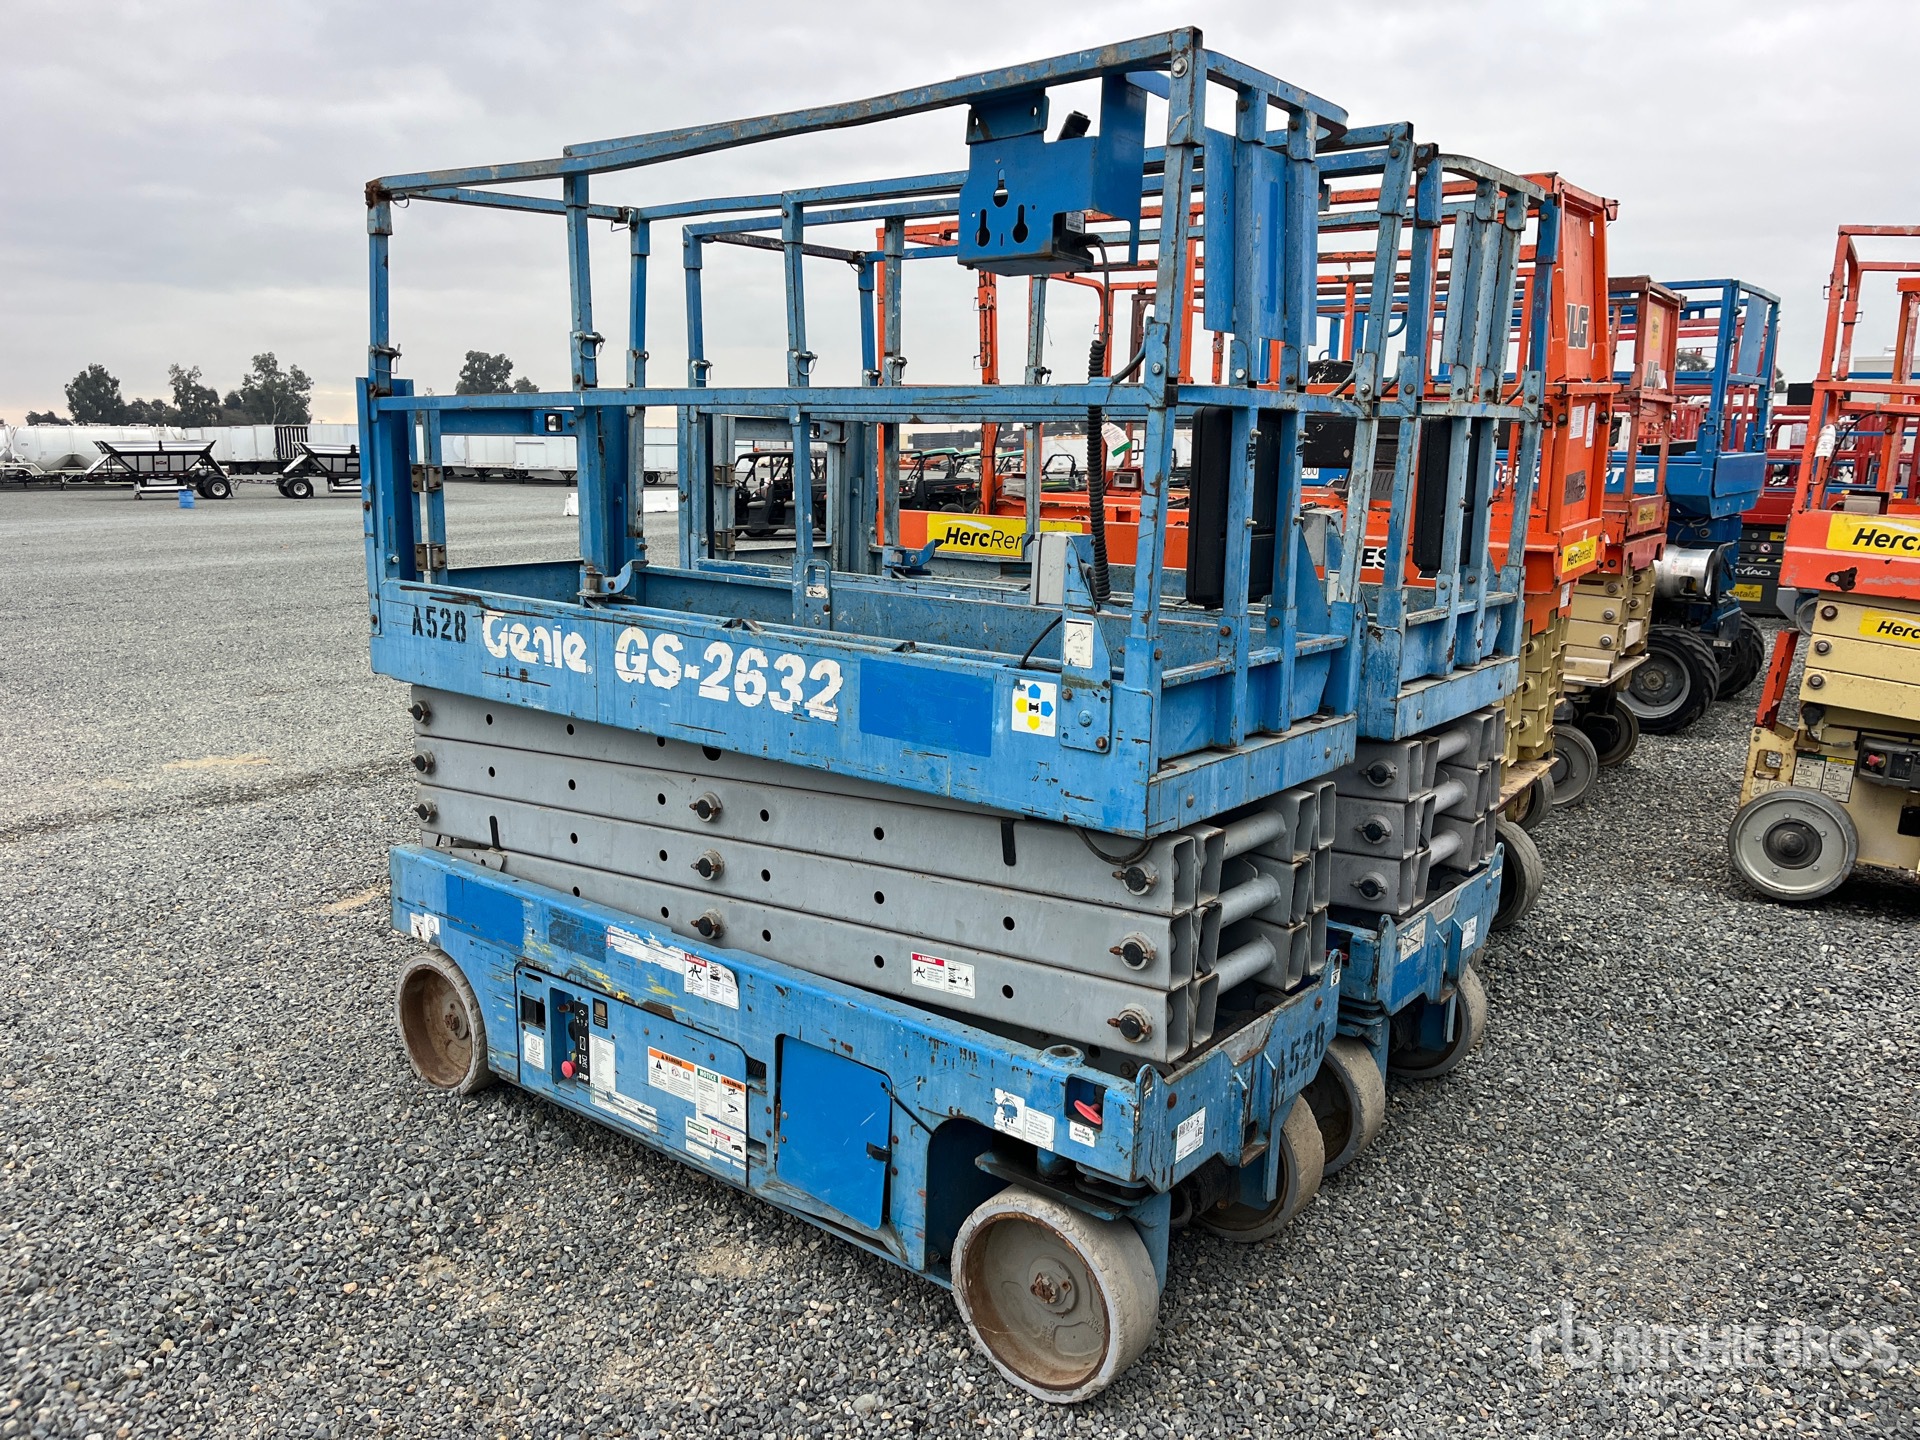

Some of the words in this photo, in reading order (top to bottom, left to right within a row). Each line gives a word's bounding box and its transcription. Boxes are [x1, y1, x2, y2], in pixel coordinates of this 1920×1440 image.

[1852, 527, 1920, 551] Herc
[411, 606, 467, 643] A528
[614, 626, 844, 722] GS-2632
[699, 1069, 717, 1082] NOTICE
